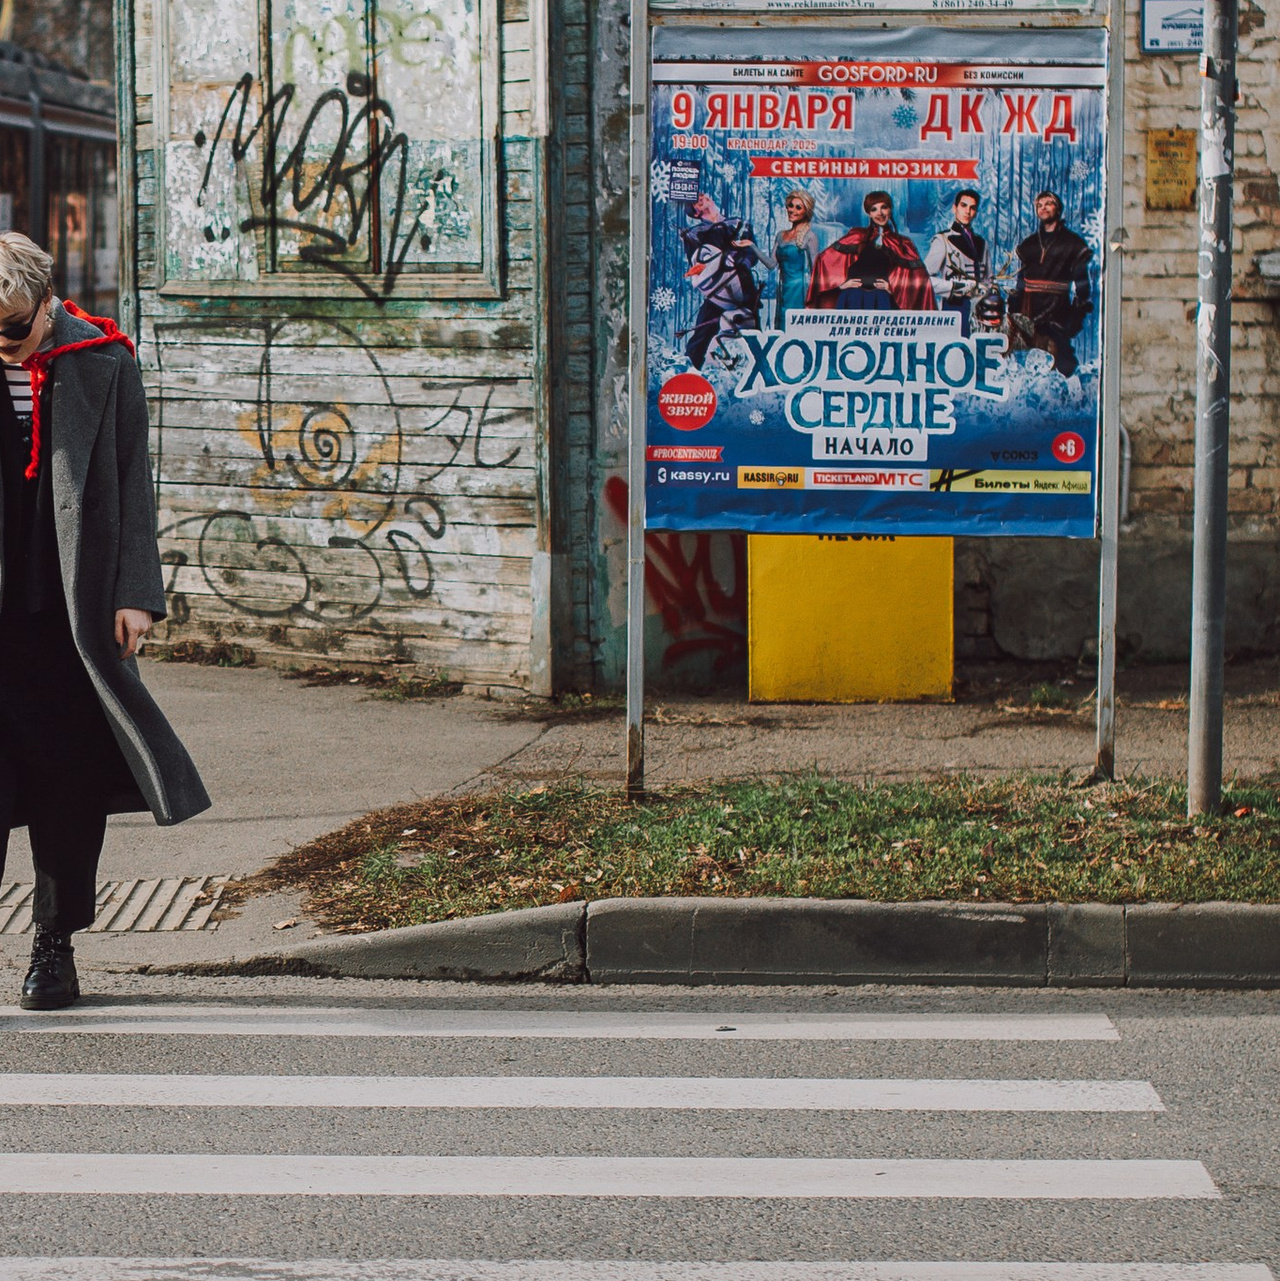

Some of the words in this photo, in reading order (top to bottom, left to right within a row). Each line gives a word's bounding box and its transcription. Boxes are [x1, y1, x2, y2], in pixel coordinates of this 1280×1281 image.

[767, 0, 875, 9] www.reklamacity23.ru
[932, 0, 938, 8] 8
[941, 0, 965, 9] (861)
[968, 0, 1014, 8] 240-34-49
[732, 68, 765, 77] БИЛЕТЫ
[767, 68, 778, 77] НА
[780, 67, 805, 78] САЙТЕ
[963, 70, 979, 80] БЕЗ
[980, 70, 1024, 81] КОМИССИИ
[673, 92, 693, 129] 9
[705, 93, 853, 130] ЯНВАРЯ
[921, 94, 984, 141] ДК
[1002, 95, 1077, 143] ЖД
[672, 134, 708, 149] 19:00
[727, 138, 787, 151] КРАСНОДАР
[793, 139, 817, 150] 2025
[771, 159, 870, 175] СЕМЕЙНЫЙ
[878, 162, 958, 176] МЮЗИКЛ
[790, 314, 869, 325] УДИВИТЕЛЬНОЕ
[872, 315, 956, 327] ПРЕДСТАВЛЕНИЕ
[829, 326, 854, 337] ДЛЯ
[855, 325, 880, 336] ВСЕЙ
[883, 326, 917, 337] СЕМЬИ
[740, 334, 1005, 397] ХОЛОДНОЕ
[660, 392, 714, 405] ЖИВОЙ
[667, 406, 708, 417] ЗВУК!
[790, 386, 952, 434] СЕРДЦЕ
[825, 437, 914, 456] НАЧАЛО
[1058, 438, 1076, 457] +6
[653, 448, 718, 460] #PROCENTRSOUZ
[1001, 450, 1039, 460] СОЮЗ
[670, 470, 730, 484] kassy.ru
[816, 474, 876, 484] TICKETLAND
[974, 478, 1030, 489] Билеты
[1033, 479, 1059, 490] Яндекс
[1061, 480, 1088, 491] Афиша
